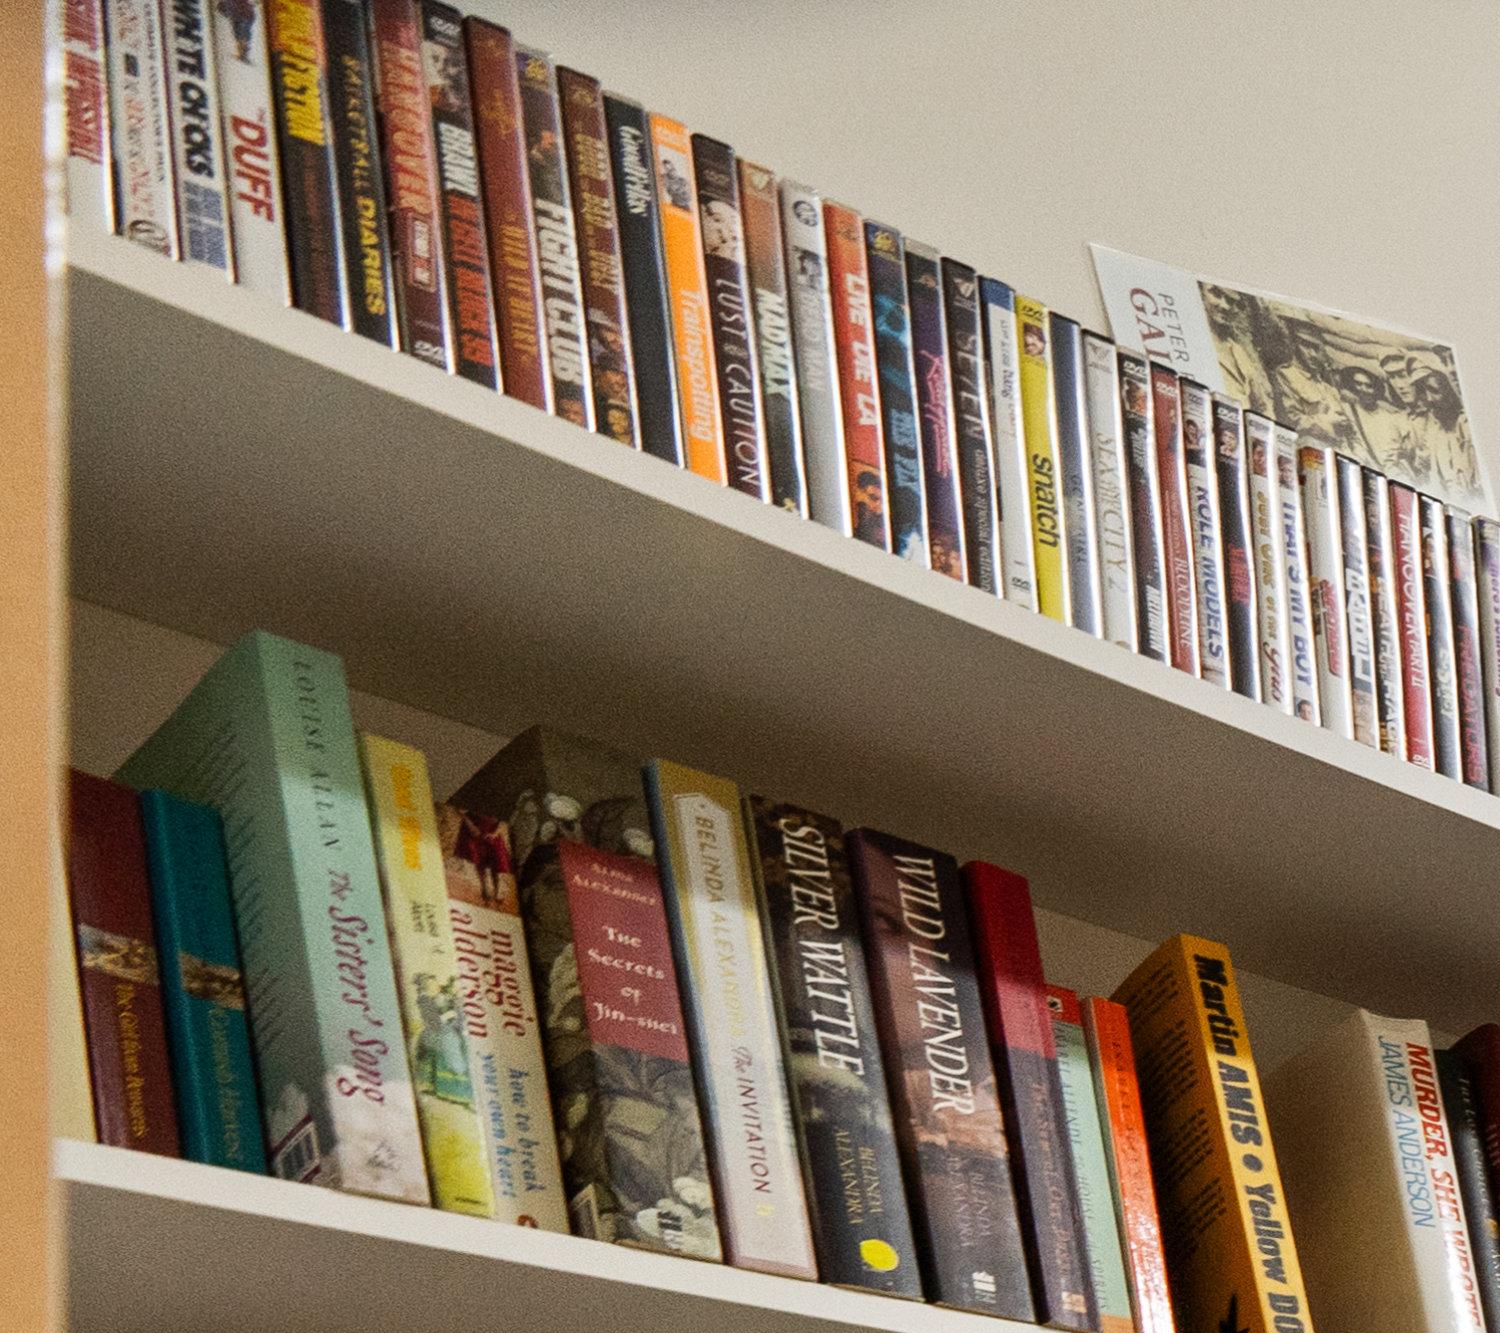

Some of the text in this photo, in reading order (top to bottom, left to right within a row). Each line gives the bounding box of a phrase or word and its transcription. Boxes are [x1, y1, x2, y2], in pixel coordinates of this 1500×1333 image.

[230, 113, 275, 223] DUFF
[356, 198, 386, 316] DIARIES
[534, 198, 584, 385] FIGHT CLUB
[679, 287, 715, 444] Trainspotting
[715, 278, 761, 486] LUST CAUTION
[1159, 292, 1191, 363] PETER
[1029, 453, 1061, 549] snatch
[1196, 486, 1224, 661] ROLE MODELS
[329, 897, 377, 1028] Sisters'
[447, 906, 489, 1040] alderson
[490, 928, 529, 1039] maggie
[779, 817, 866, 1080] SILVER WATTLE
[892, 852, 974, 1116] WILD LAVENDER
[1192, 952, 1241, 1057] Martin
[335, 1028, 391, 1105] Song
[1216, 1060, 1263, 1149] AMIS
[1377, 1034, 1437, 1229] JAMES ANDERSON
[1405, 1042, 1461, 1224] MURDER, SHE
[1232, 1177, 1289, 1290] Yellow
